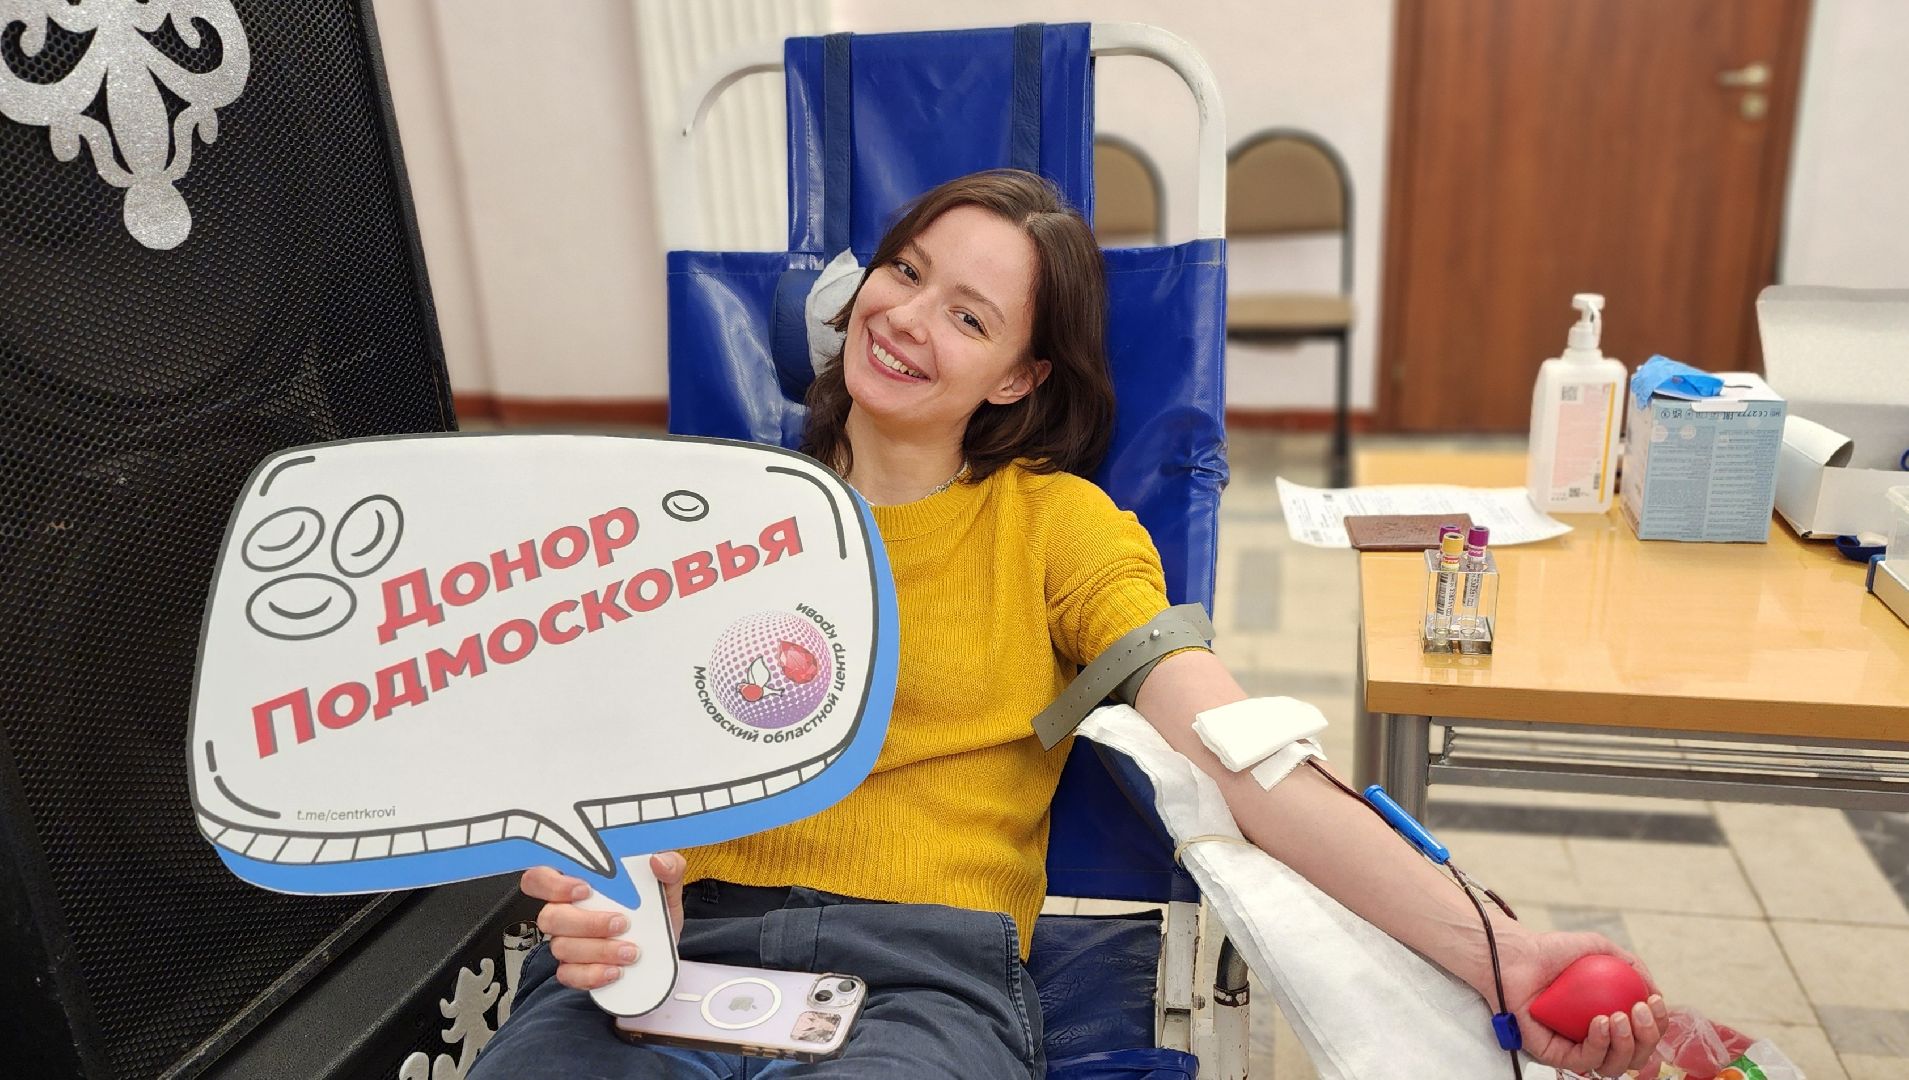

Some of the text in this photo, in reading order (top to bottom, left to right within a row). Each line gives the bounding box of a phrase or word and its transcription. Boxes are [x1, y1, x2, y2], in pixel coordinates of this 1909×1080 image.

[251, 516, 804, 760] Подмосковья
[376, 506, 641, 645] Донор
[693, 602, 847, 744] Московский областной центр крови
[296, 805, 397, 823] t.me/centrkrovi
